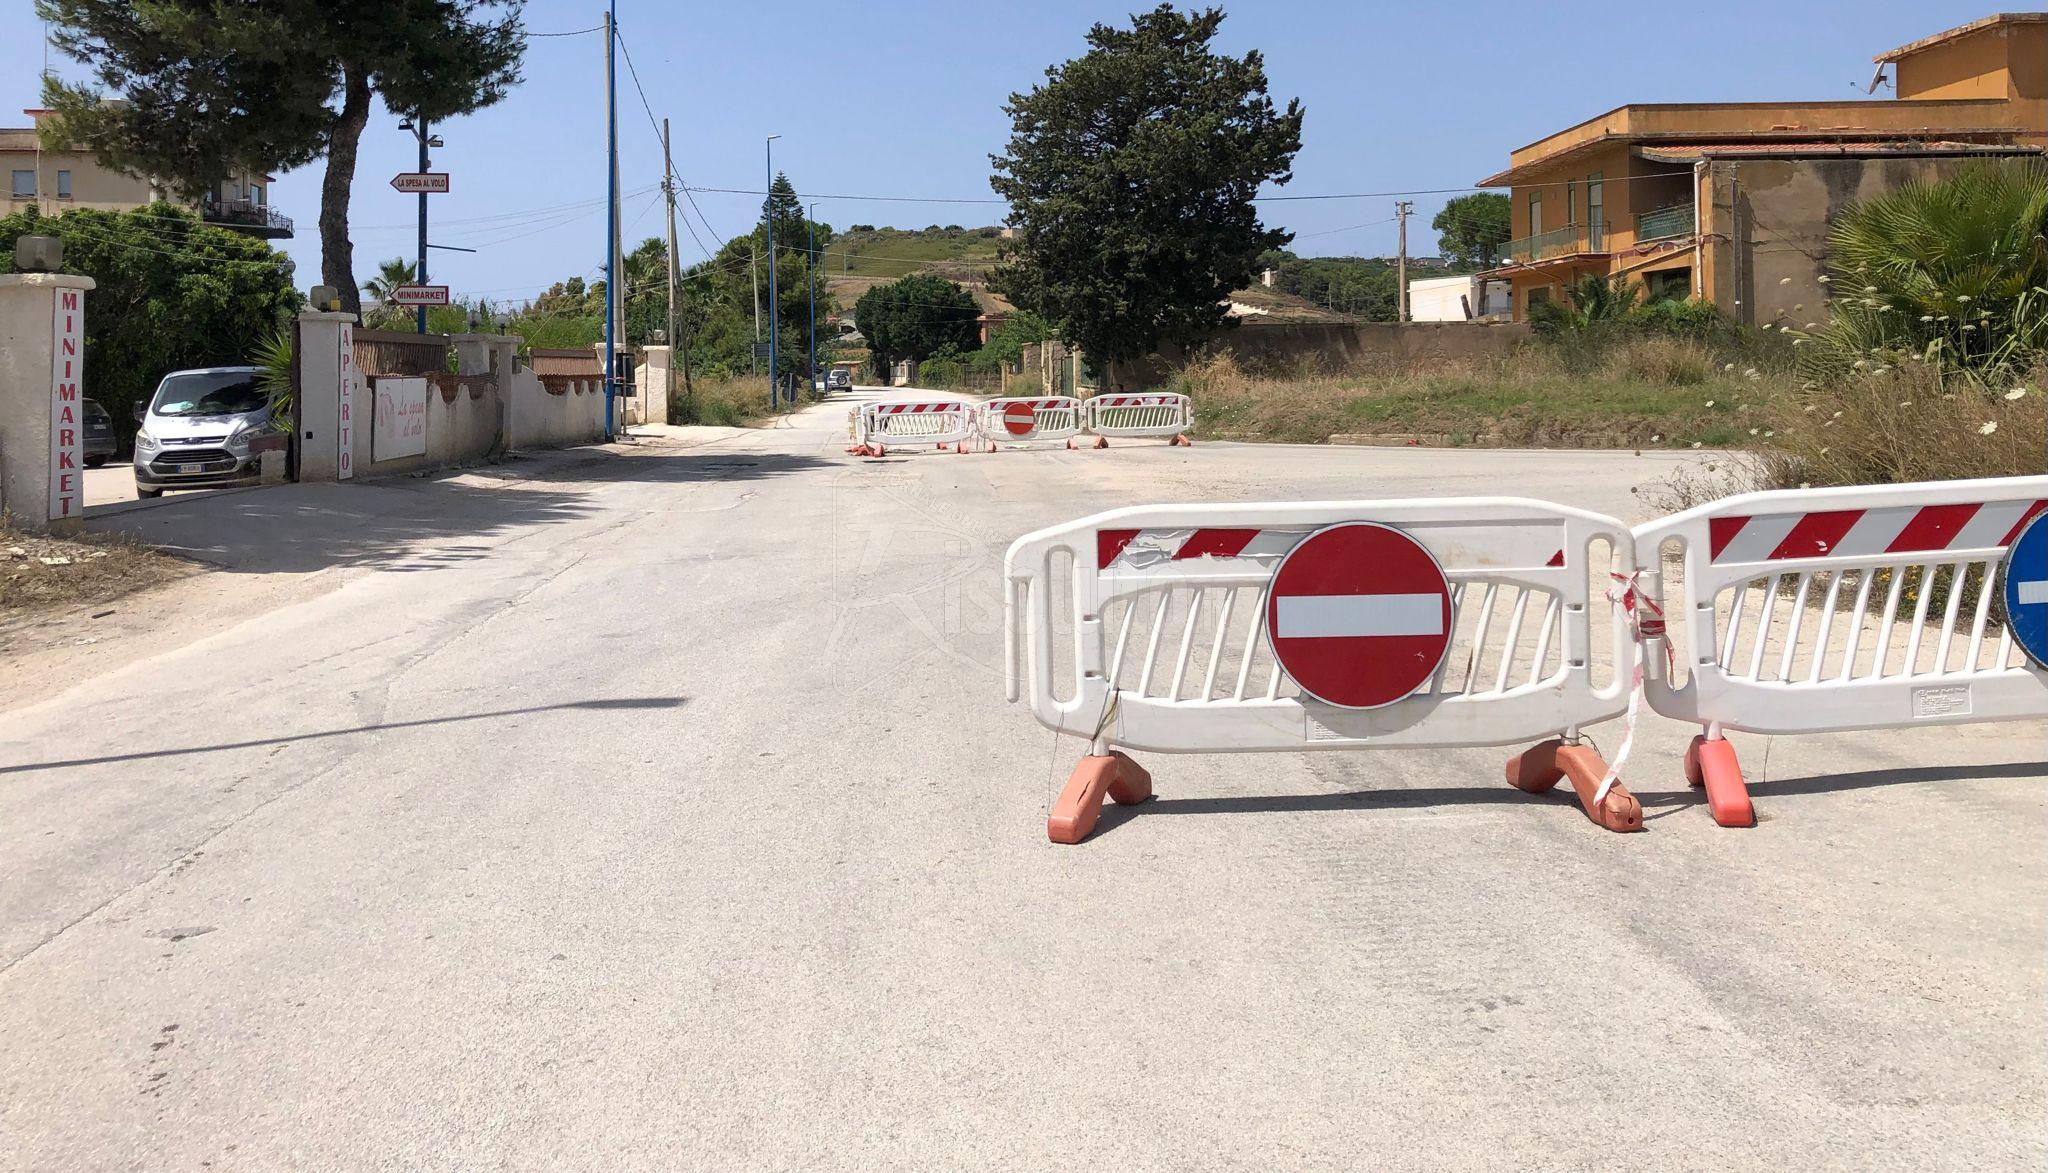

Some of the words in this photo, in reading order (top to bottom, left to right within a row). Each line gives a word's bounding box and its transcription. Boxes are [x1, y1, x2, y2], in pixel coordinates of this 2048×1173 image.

[398, 179, 404, 187] LA
[406, 179, 422, 187] SPESA
[423, 179, 430, 187] AL
[431, 179, 445, 187] VOLO
[398, 291, 445, 300] MINIMARKET
[59, 293, 77, 515] MINIMARKET
[342, 329, 350, 470] APERTO
